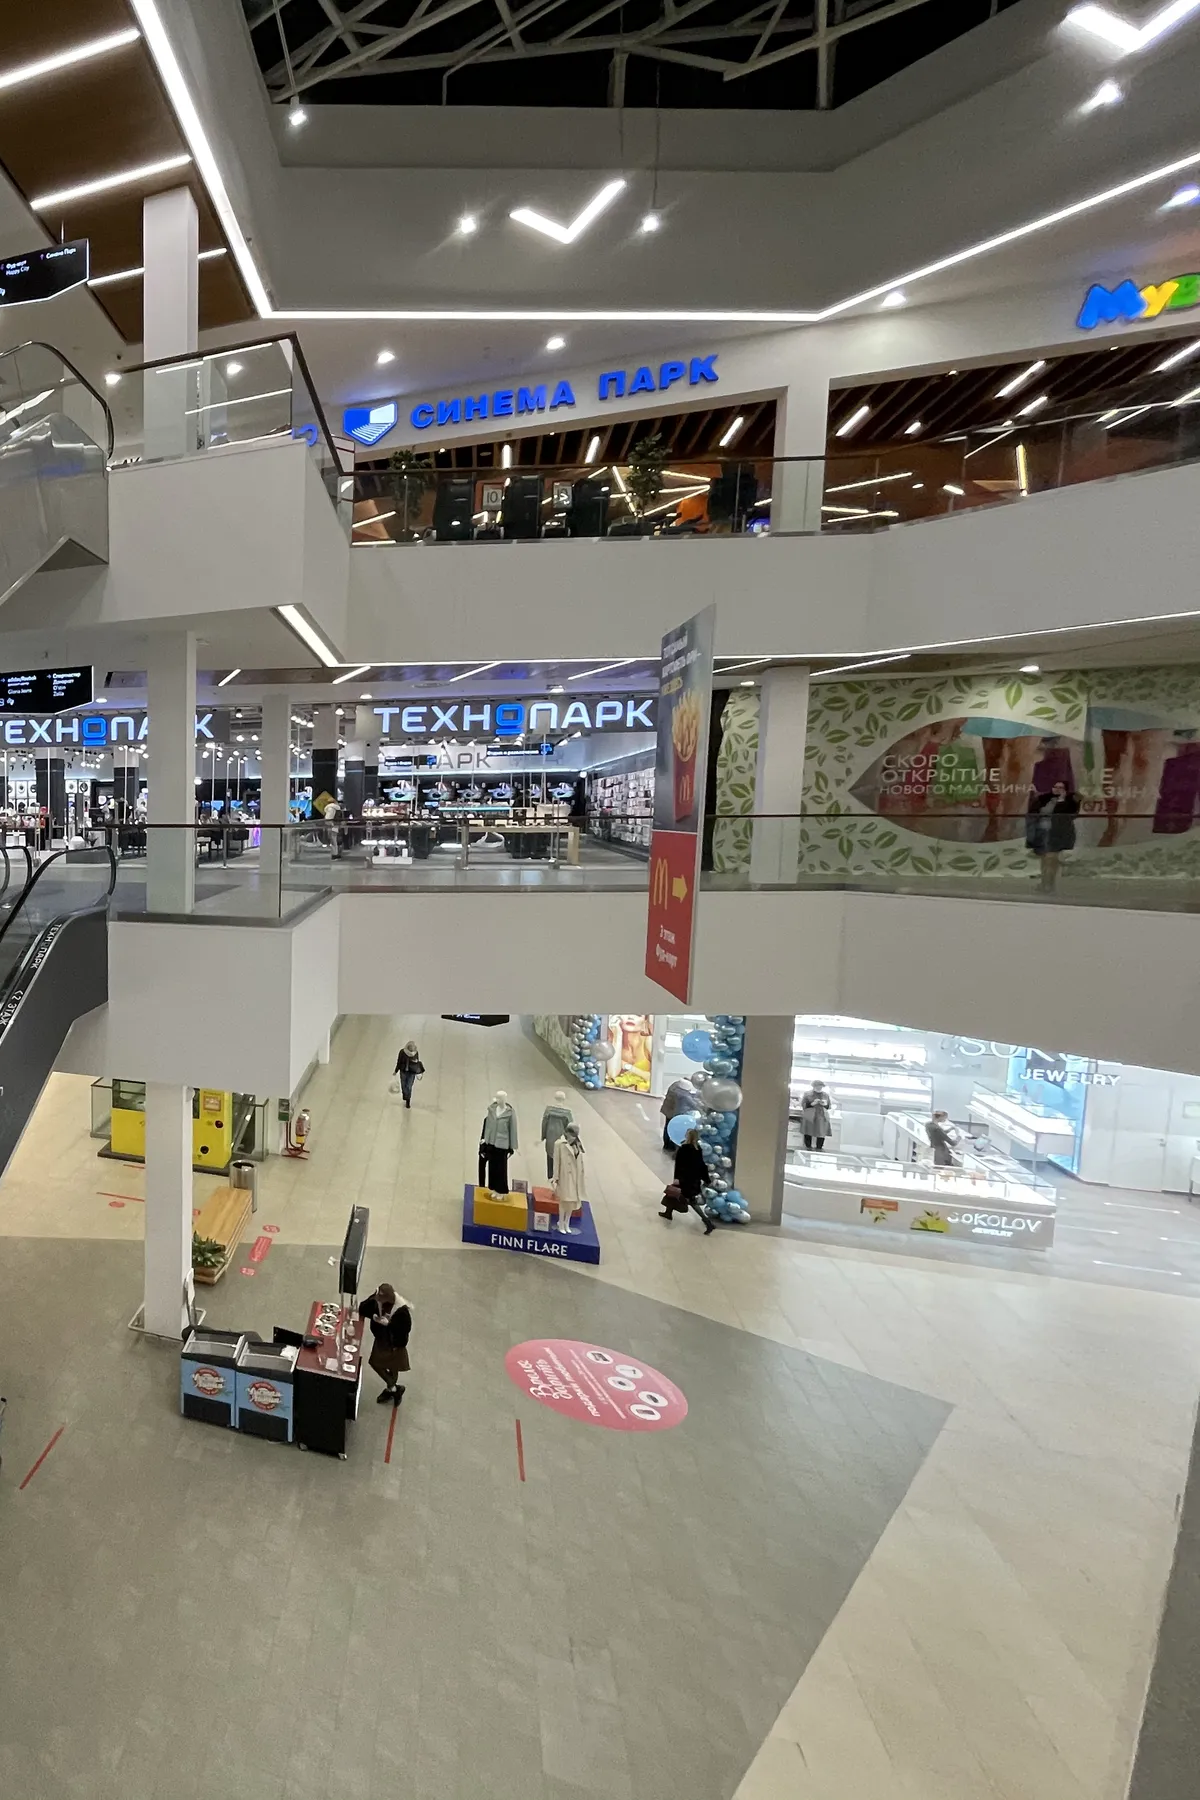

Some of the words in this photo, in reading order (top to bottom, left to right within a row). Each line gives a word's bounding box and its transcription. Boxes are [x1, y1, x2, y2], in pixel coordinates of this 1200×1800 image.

[409, 380, 577, 429] СИНЕМА
[599, 354, 719, 400] ПАРК
[486, 491, 499, 504] 10
[373, 699, 654, 735] ТЕХНОПАРК
[883, 754, 959, 769] СКОРО
[881, 767, 1001, 783] ОТКРЫТИЕ
[880, 784, 945, 795] НОВОГО
[951, 784, 1037, 795] МАГАЗИНА
[1020, 1068, 1121, 1087] JEWELRY
[947, 1212, 1042, 1233] SOKOLOV
[491, 1233, 523, 1249] FINN
[527, 1239, 569, 1257] FLARE
